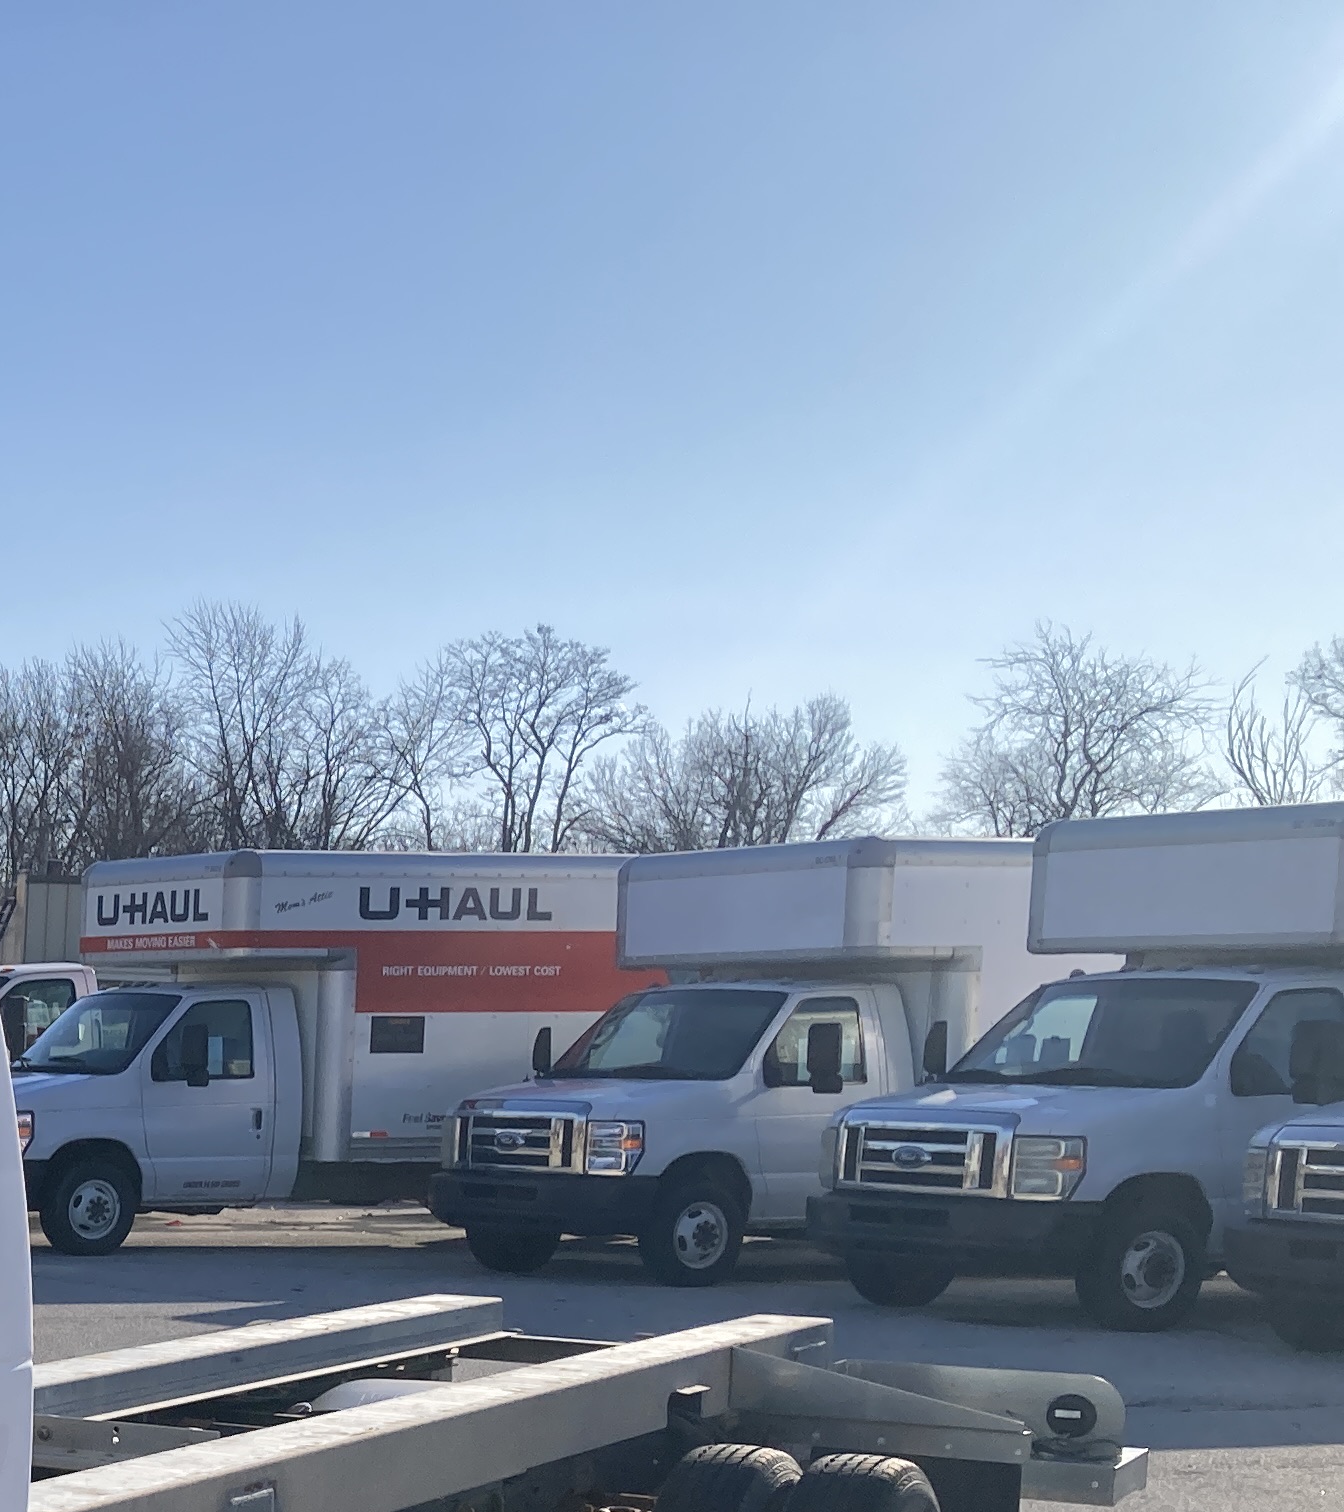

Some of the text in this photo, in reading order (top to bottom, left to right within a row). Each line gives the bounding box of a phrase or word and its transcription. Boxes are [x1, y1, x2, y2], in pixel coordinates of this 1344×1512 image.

[97, 888, 209, 926] U-HAUL
[359, 886, 553, 921] U-HAUL
[106, 935, 196, 950] MAKES MOVING EASIER
[382, 965, 413, 977] RIGHT
[417, 965, 479, 977] EQUIPMENT
[489, 965, 531, 977] LOWEST
[533, 965, 562, 977] COST
